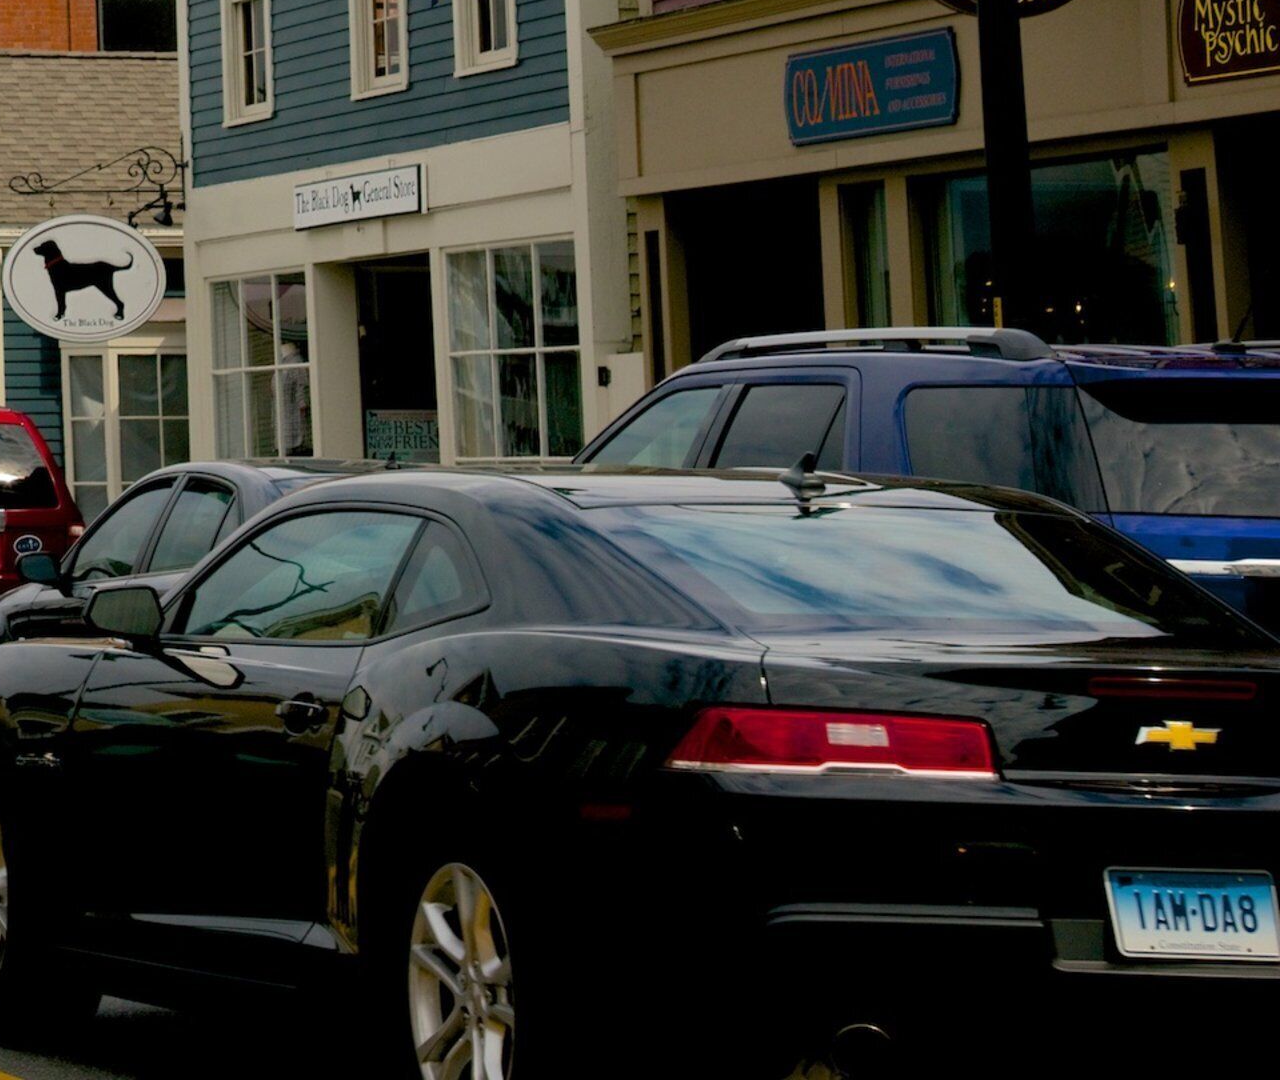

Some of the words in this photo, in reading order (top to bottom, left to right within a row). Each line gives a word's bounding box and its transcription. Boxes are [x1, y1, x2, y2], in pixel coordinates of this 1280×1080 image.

[1201, 21, 1279, 67] Psychic
[296, 192, 310, 214] The
[311, 189, 331, 211] Black
[332, 185, 350, 213] Dog
[363, 178, 392, 203] General
[393, 175, 416, 199] Store
[63, 319, 76, 327] The
[79, 318, 98, 327] Black
[99, 318, 114, 328] Dog
[394, 420, 434, 435] BEST
[395, 435, 439, 449] FRIEN
[1159, 939, 1215, 950] Constitution
[1218, 941, 1241, 951] State
